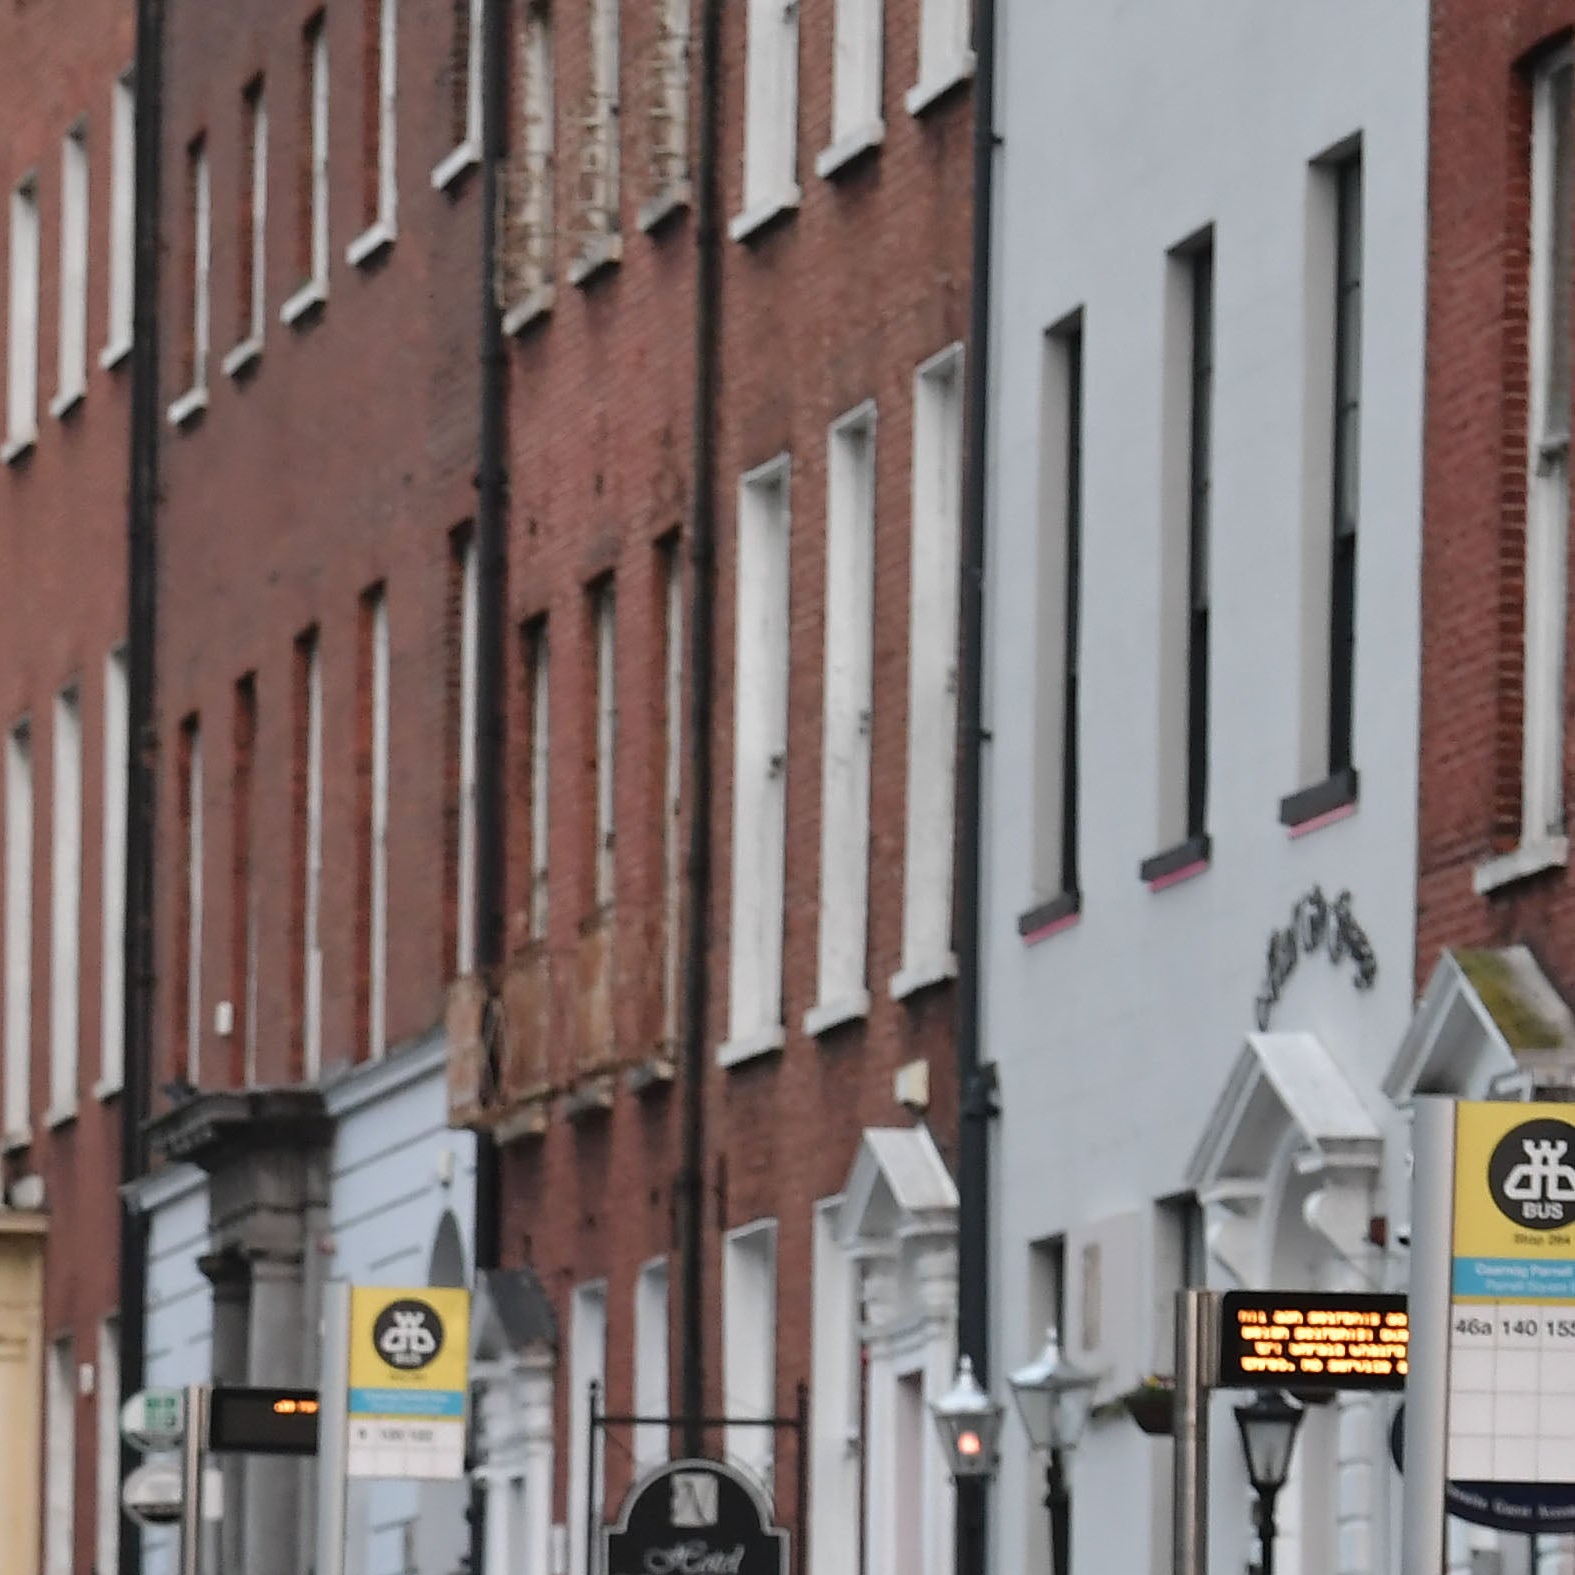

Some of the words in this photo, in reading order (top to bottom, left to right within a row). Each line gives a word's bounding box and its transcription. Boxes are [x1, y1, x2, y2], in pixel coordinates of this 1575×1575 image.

[1522, 1202, 1564, 1219] BUS
[1455, 1318, 1493, 1336] 46a
[1502, 1319, 1538, 1336] 140
